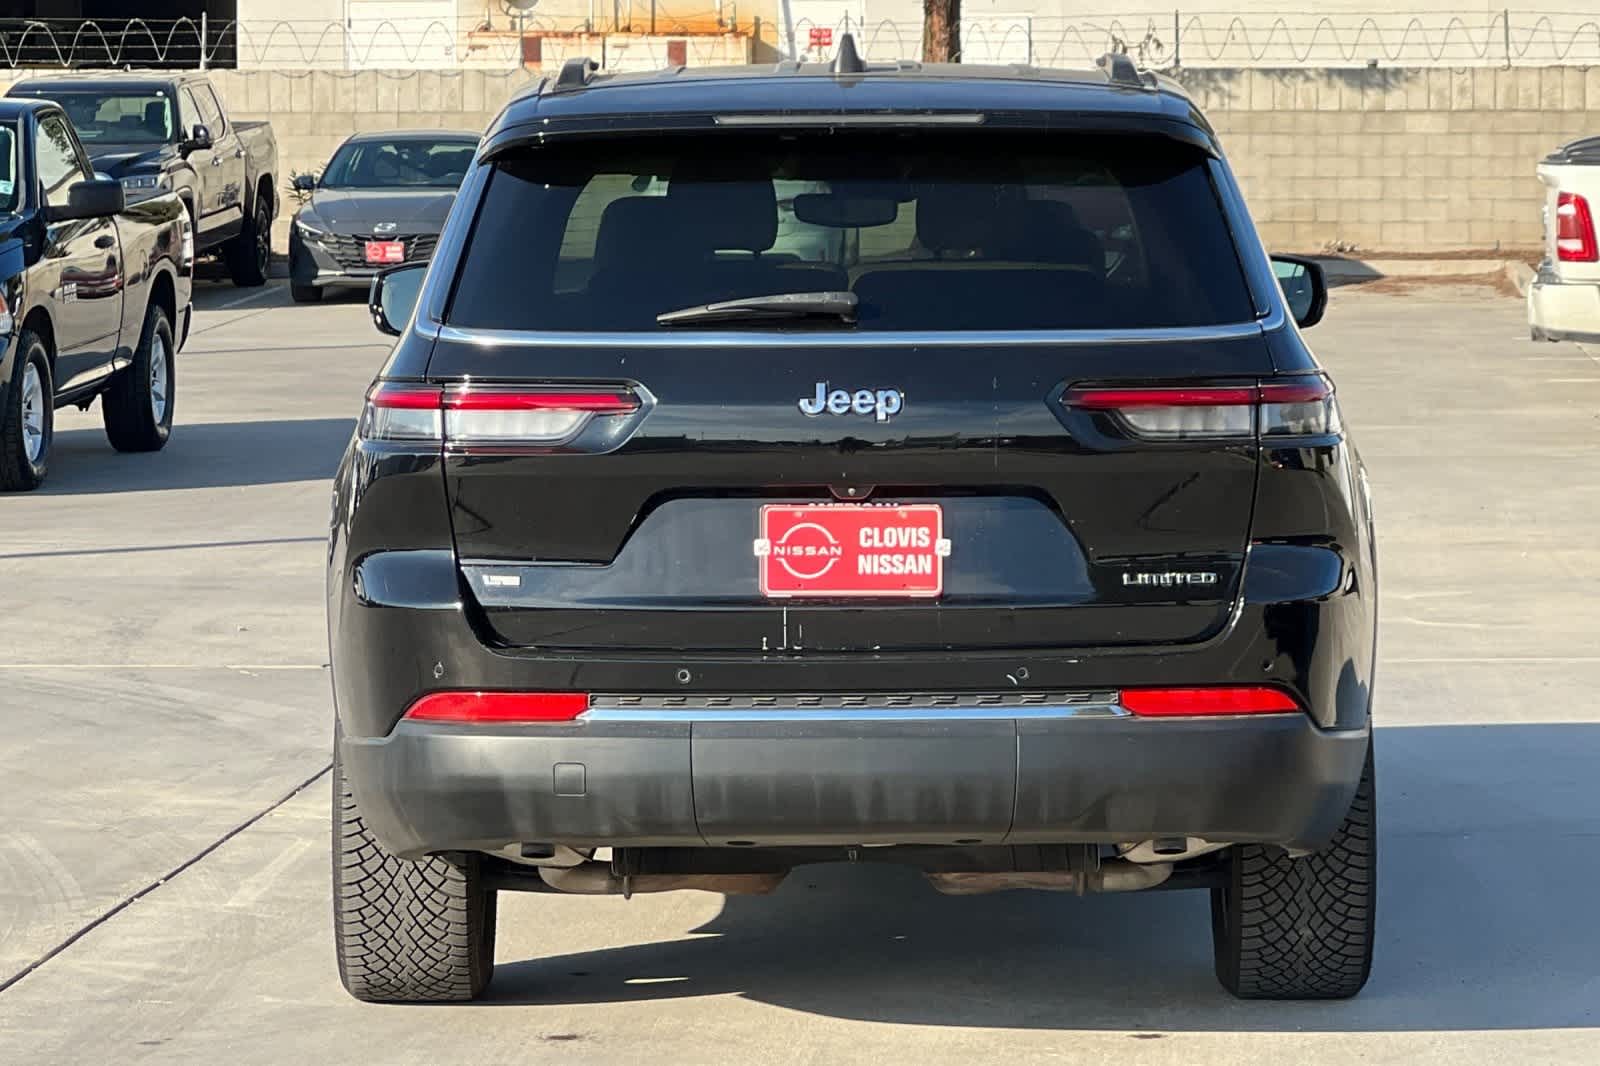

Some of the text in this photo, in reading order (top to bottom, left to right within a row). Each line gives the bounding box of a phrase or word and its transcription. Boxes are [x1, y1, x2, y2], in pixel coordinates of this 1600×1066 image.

[798, 382, 904, 423] Jeep
[859, 527, 931, 547] CLOVIS
[773, 546, 842, 556] NISSAN
[857, 554, 932, 575] NISSAN
[1122, 572, 1218, 586] LIMITED
